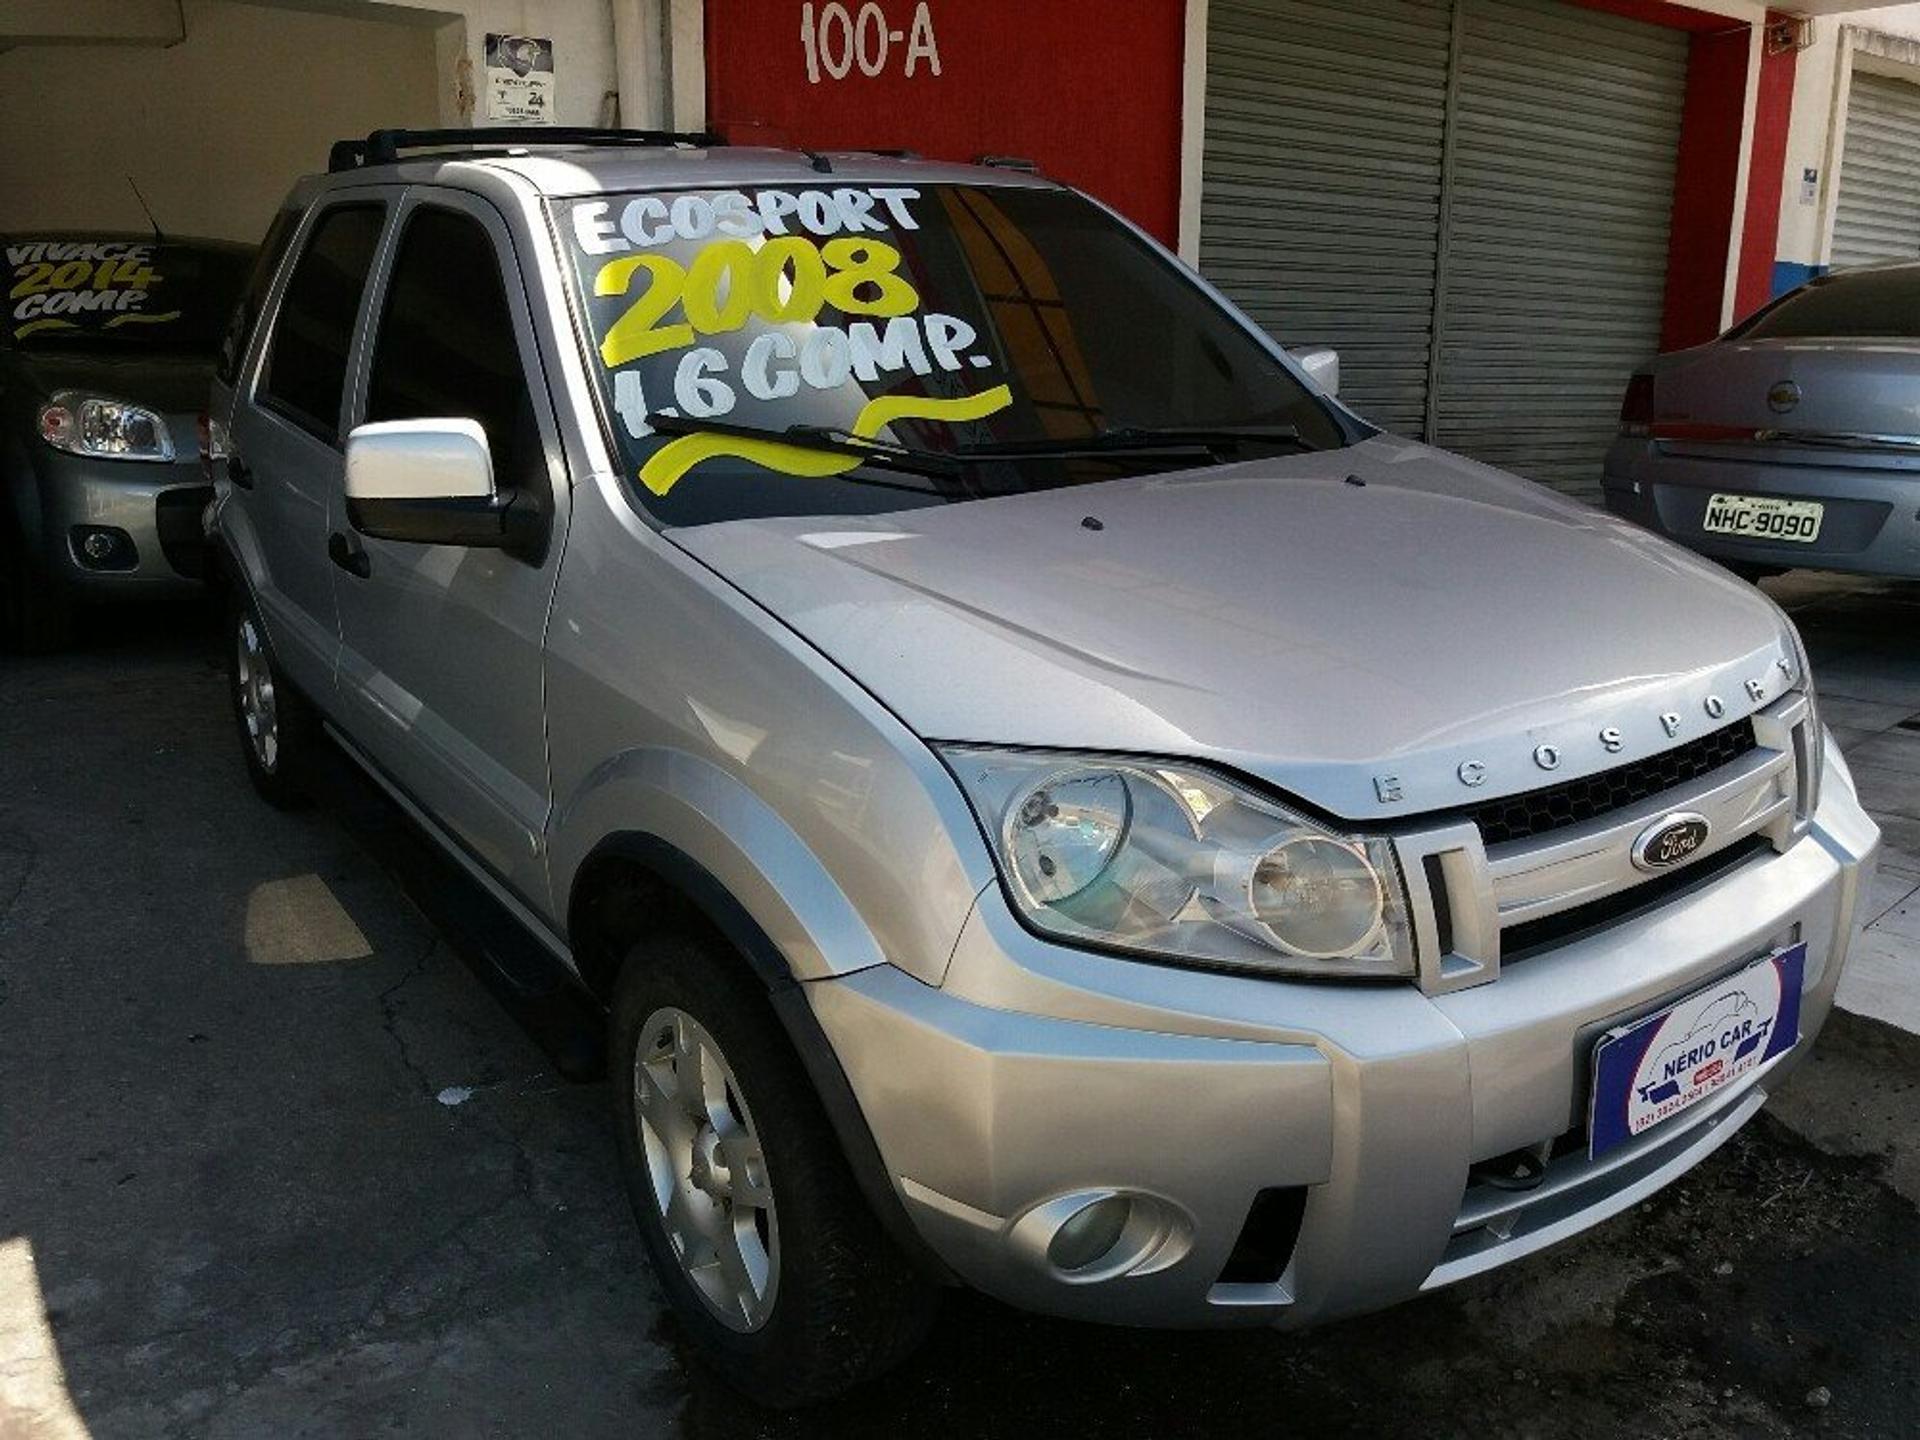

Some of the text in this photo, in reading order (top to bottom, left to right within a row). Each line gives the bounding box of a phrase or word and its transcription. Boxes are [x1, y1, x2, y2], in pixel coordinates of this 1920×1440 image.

[801, 2, 942, 84] 100-A
[572, 188, 920, 255] ECOSPORT
[6, 242, 157, 266] VIVACE
[10, 256, 164, 300] 2014
[13, 289, 149, 320] COMP.
[594, 236, 919, 368] 2008
[614, 314, 991, 439] 1.6 COMP.
[1661, 827, 1697, 860] Ford
[1720, 1019, 1752, 1049] CAR
